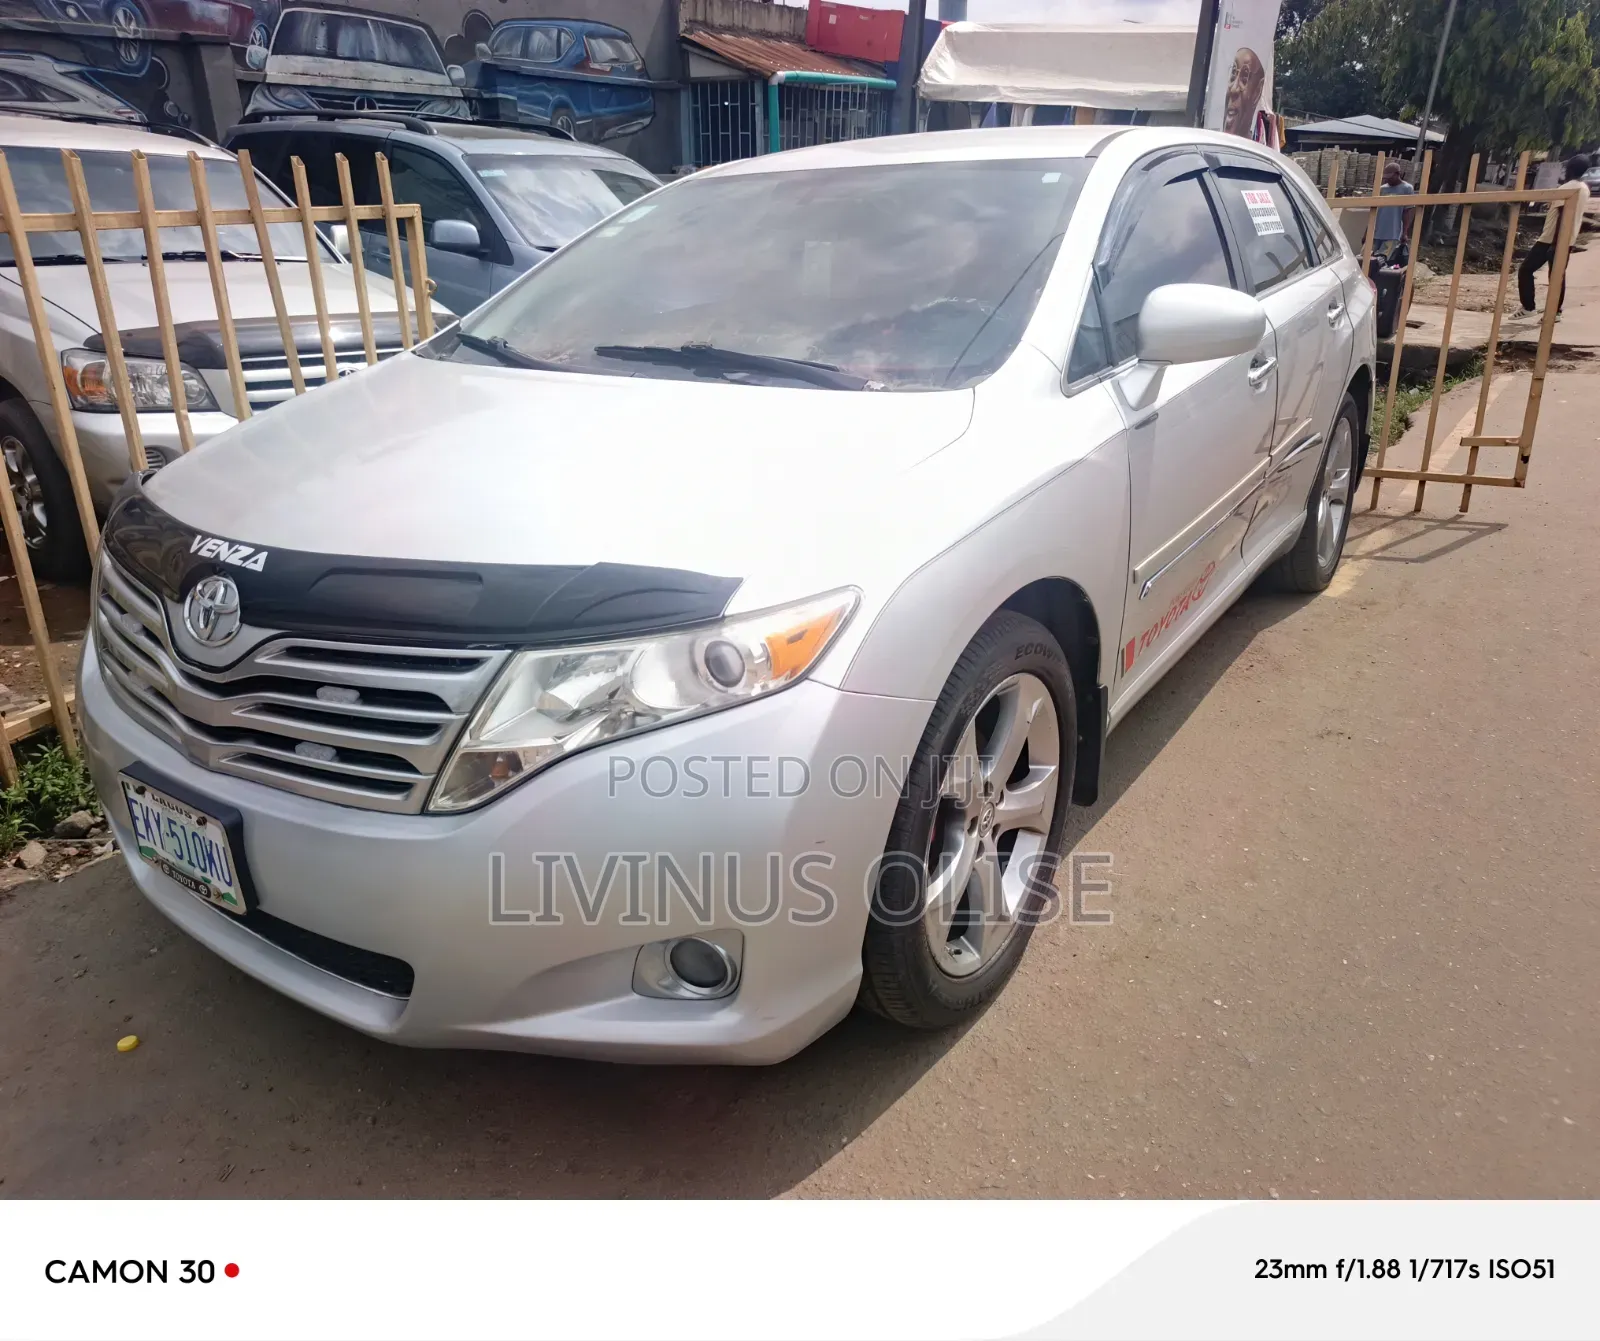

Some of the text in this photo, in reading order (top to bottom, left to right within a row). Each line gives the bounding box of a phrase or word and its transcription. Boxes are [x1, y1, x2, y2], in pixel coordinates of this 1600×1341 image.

[190, 535, 268, 572] VENZA
[1138, 591, 1193, 657] TOYOTA
[172, 870, 196, 890] TOYOTA
